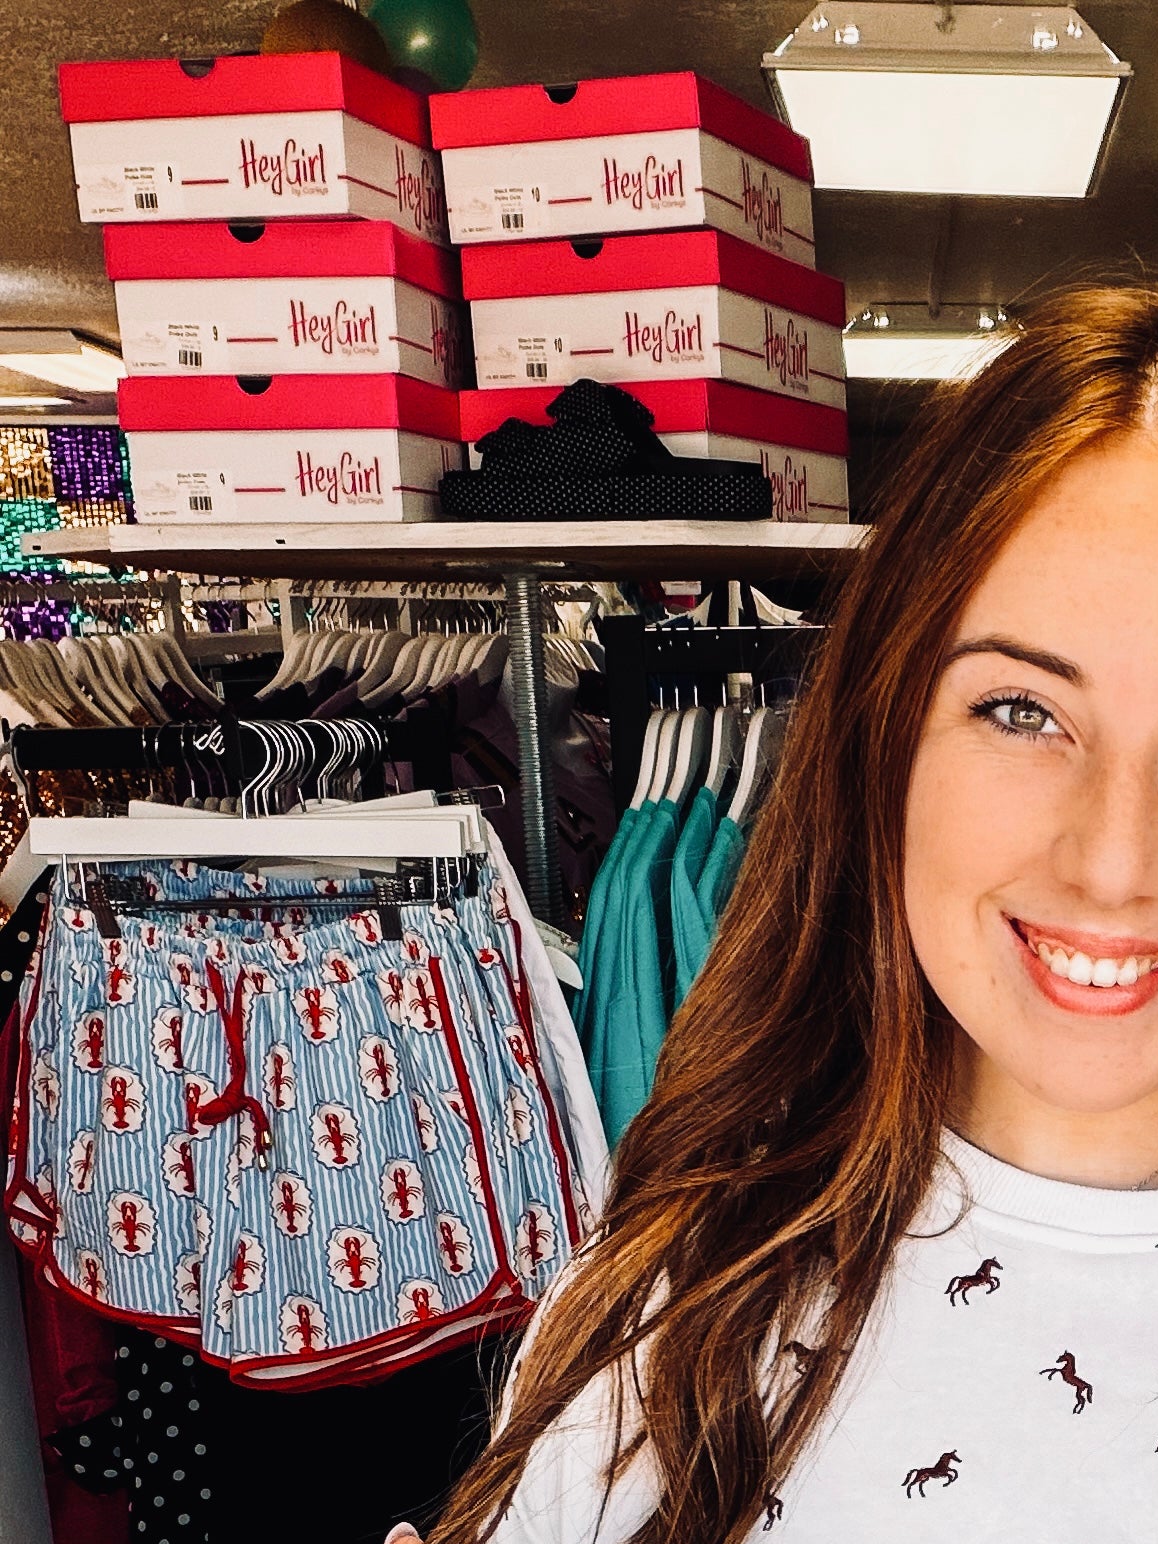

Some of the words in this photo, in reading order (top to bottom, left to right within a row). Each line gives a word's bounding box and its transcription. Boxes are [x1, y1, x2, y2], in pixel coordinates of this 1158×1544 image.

[239, 137, 327, 196] HeyGirl
[395, 143, 441, 231] HeyGir
[602, 155, 685, 210] HeyGirl
[287, 298, 378, 355] HeyGirl
[622, 310, 704, 363] HeyGirl
[295, 450, 382, 506] HeyGirl
